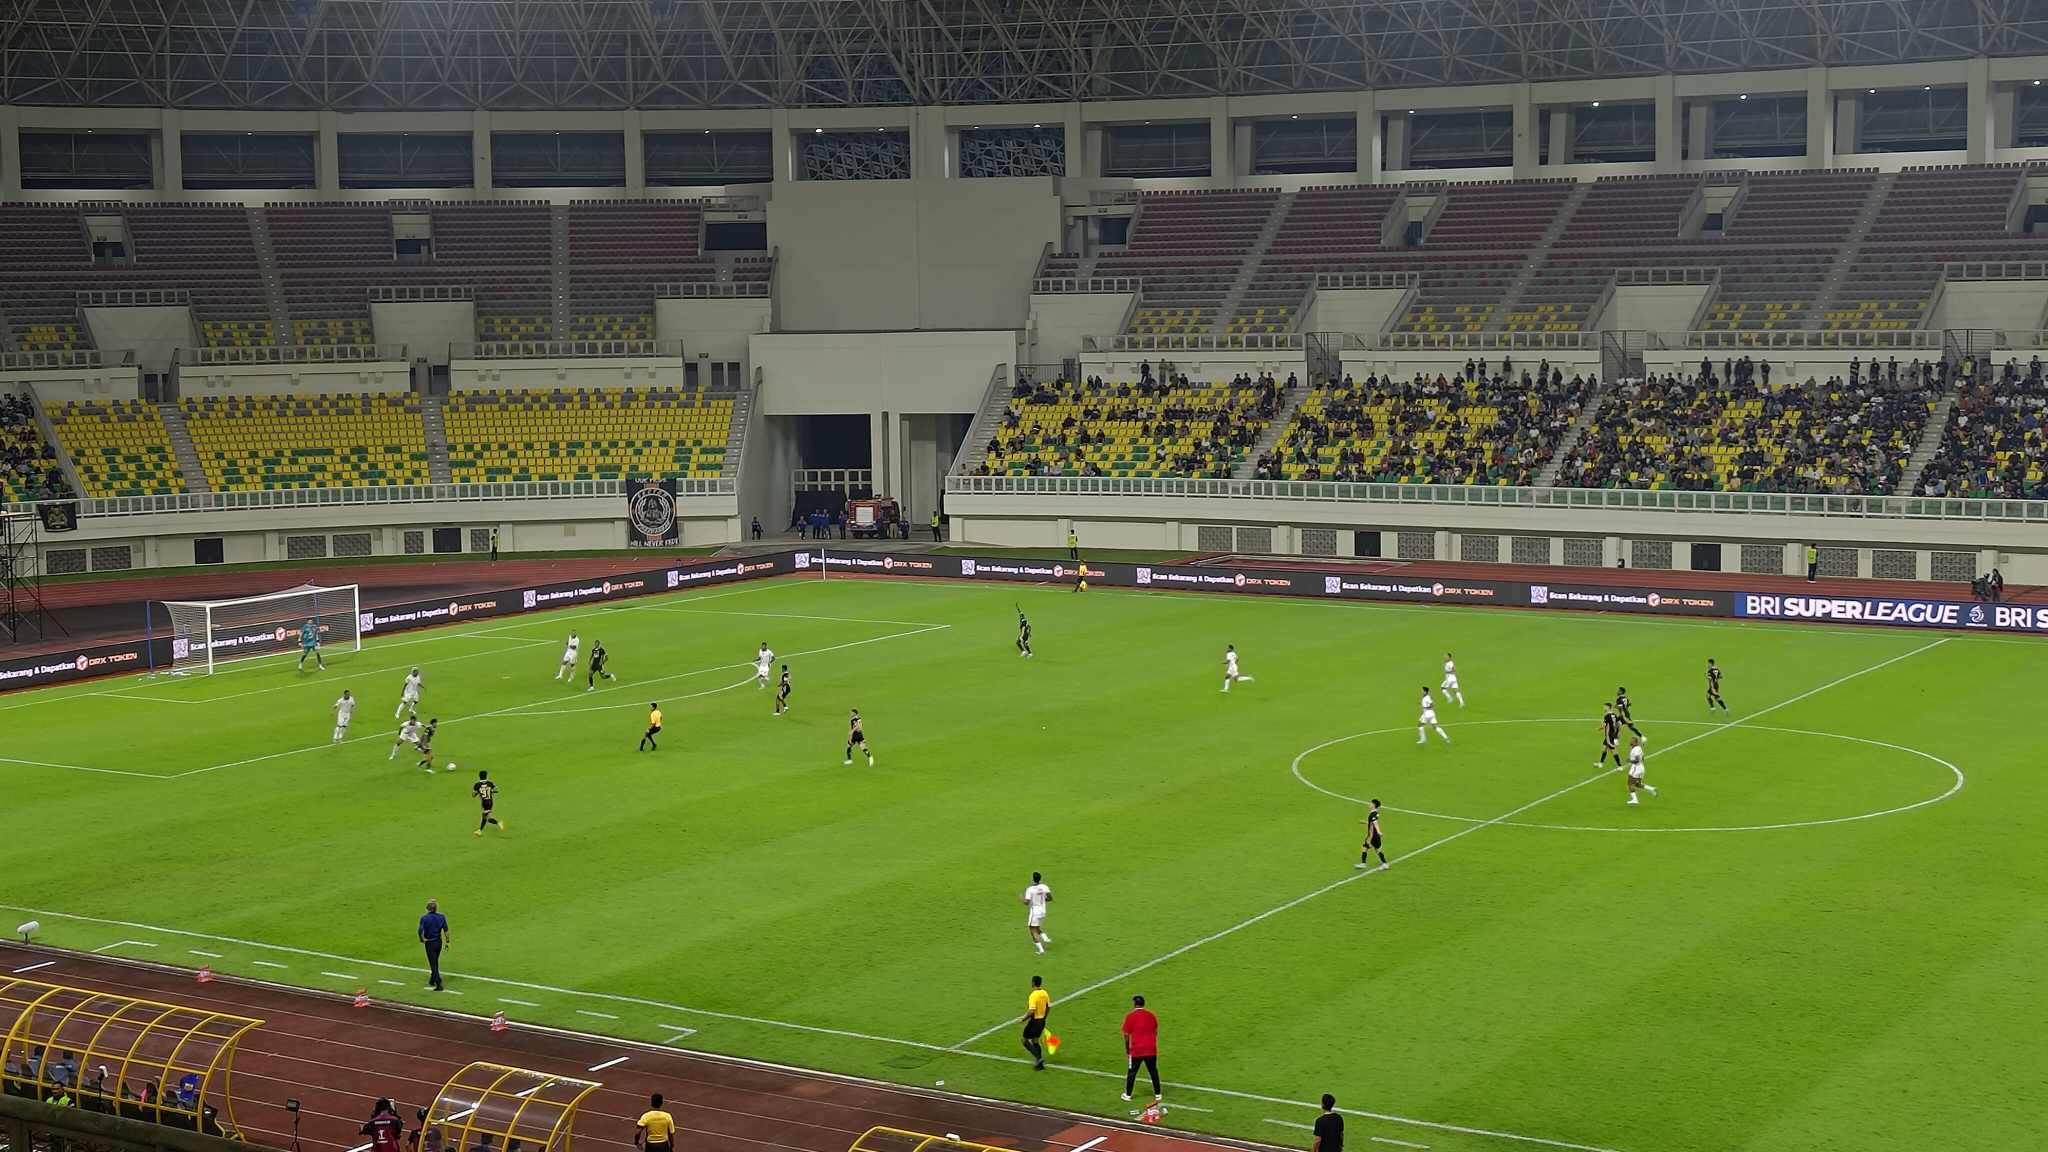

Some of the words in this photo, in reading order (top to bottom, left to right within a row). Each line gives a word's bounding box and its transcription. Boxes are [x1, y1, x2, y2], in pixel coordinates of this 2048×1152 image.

[1152, 573, 1167, 581] Scan
[1169, 574, 1197, 583] Sekarang
[1204, 576, 1234, 584] Dapatkan
[1342, 582, 1358, 590] Scan
[1360, 583, 1391, 593] Sekarang
[1398, 585, 1431, 594] Dapatkan
[1464, 588, 1493, 596] TOKEN
[1550, 592, 1567, 600] Scan
[1568, 592, 1602, 603] Sekarang
[1610, 595, 1647, 604] Dapatkan
[1682, 599, 1714, 607] TOKEN
[1747, 595, 1780, 616] BRI
[375, 616, 388, 625] Scan
[390, 613, 416, 623] Sekarang
[422, 608, 448, 618] Dapatkan
[1996, 606, 2031, 627] BRI
[190, 642, 206, 651] Scan
[210, 637, 238, 649] ekarang
[244, 633, 275, 643] Dapatkan
[41, 662, 76, 674] Dapatkan
